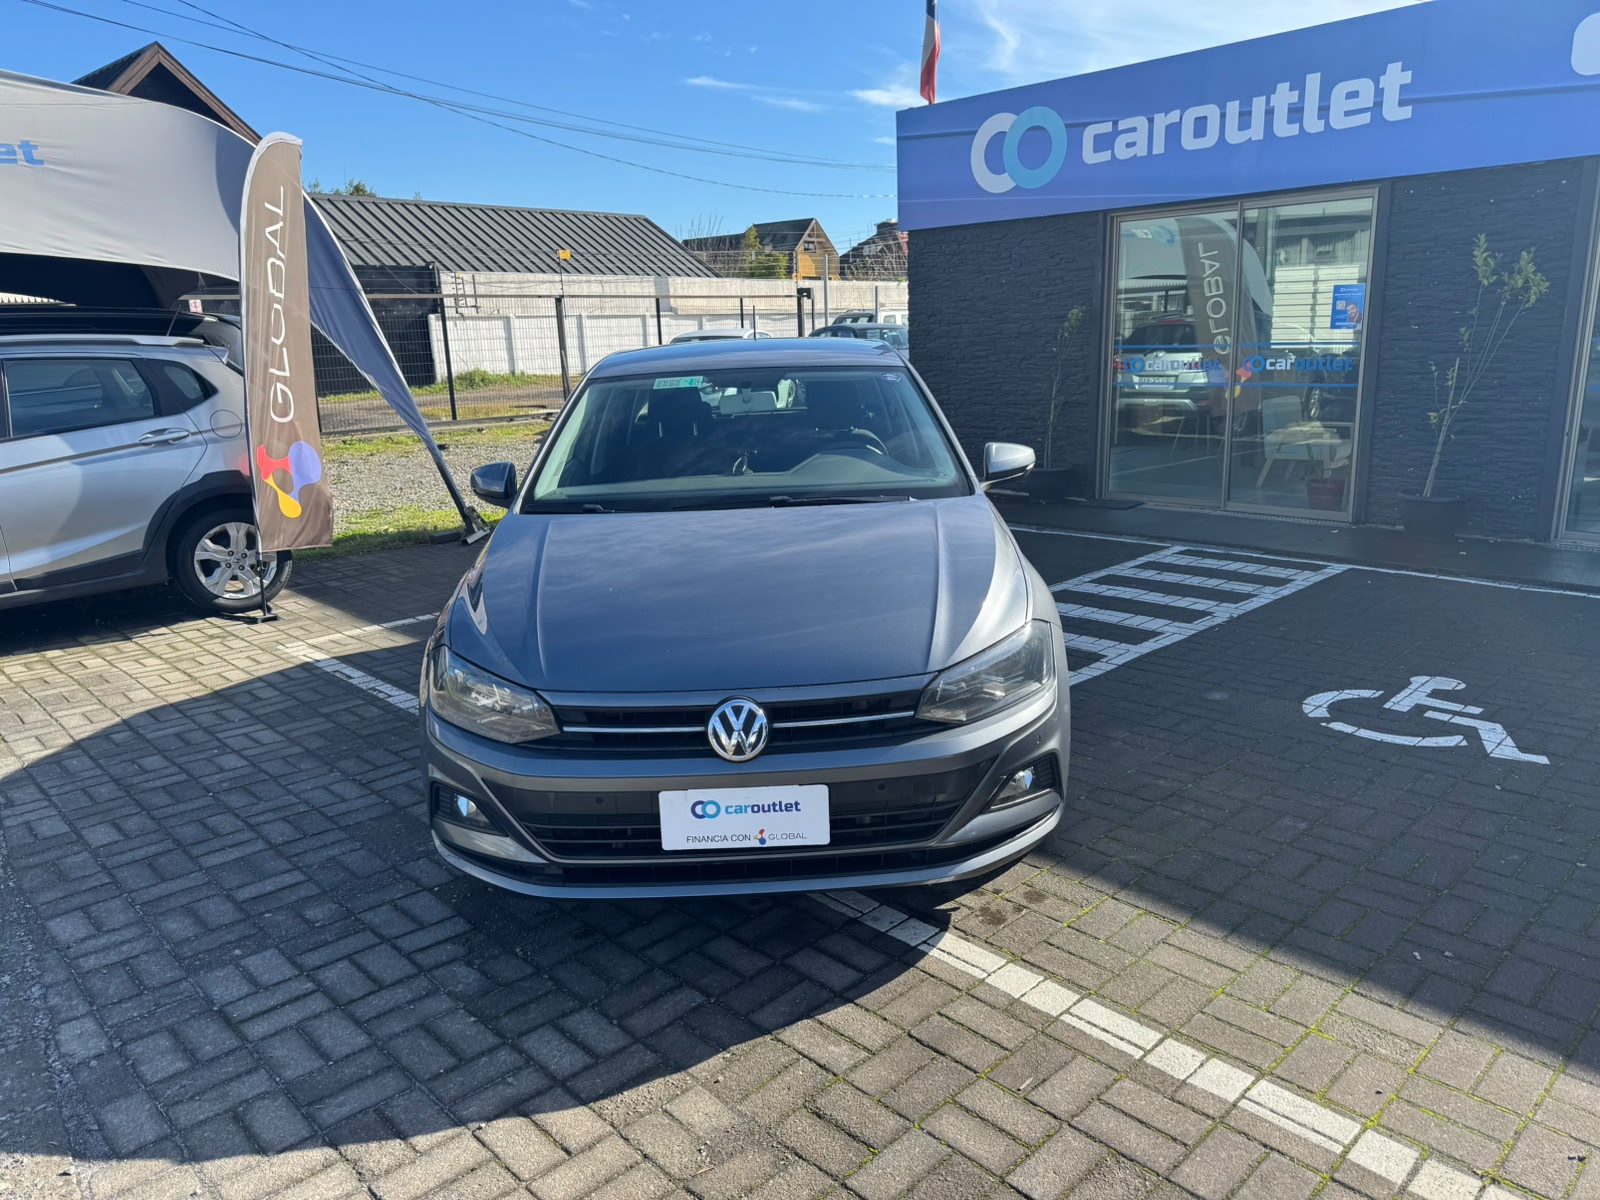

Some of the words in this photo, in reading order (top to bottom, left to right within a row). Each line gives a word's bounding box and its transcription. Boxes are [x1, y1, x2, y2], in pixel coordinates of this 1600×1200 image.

[1082, 61, 1413, 165] caroutlet
[264, 185, 295, 424] GLOBAL
[1145, 356, 1222, 372] caroutlet
[1265, 355, 1353, 372] caroutlet
[724, 800, 802, 815] caroutlet
[686, 834, 729, 844] FINANCIA
[730, 833, 751, 842] CON
[768, 832, 808, 841] GLOBAL
